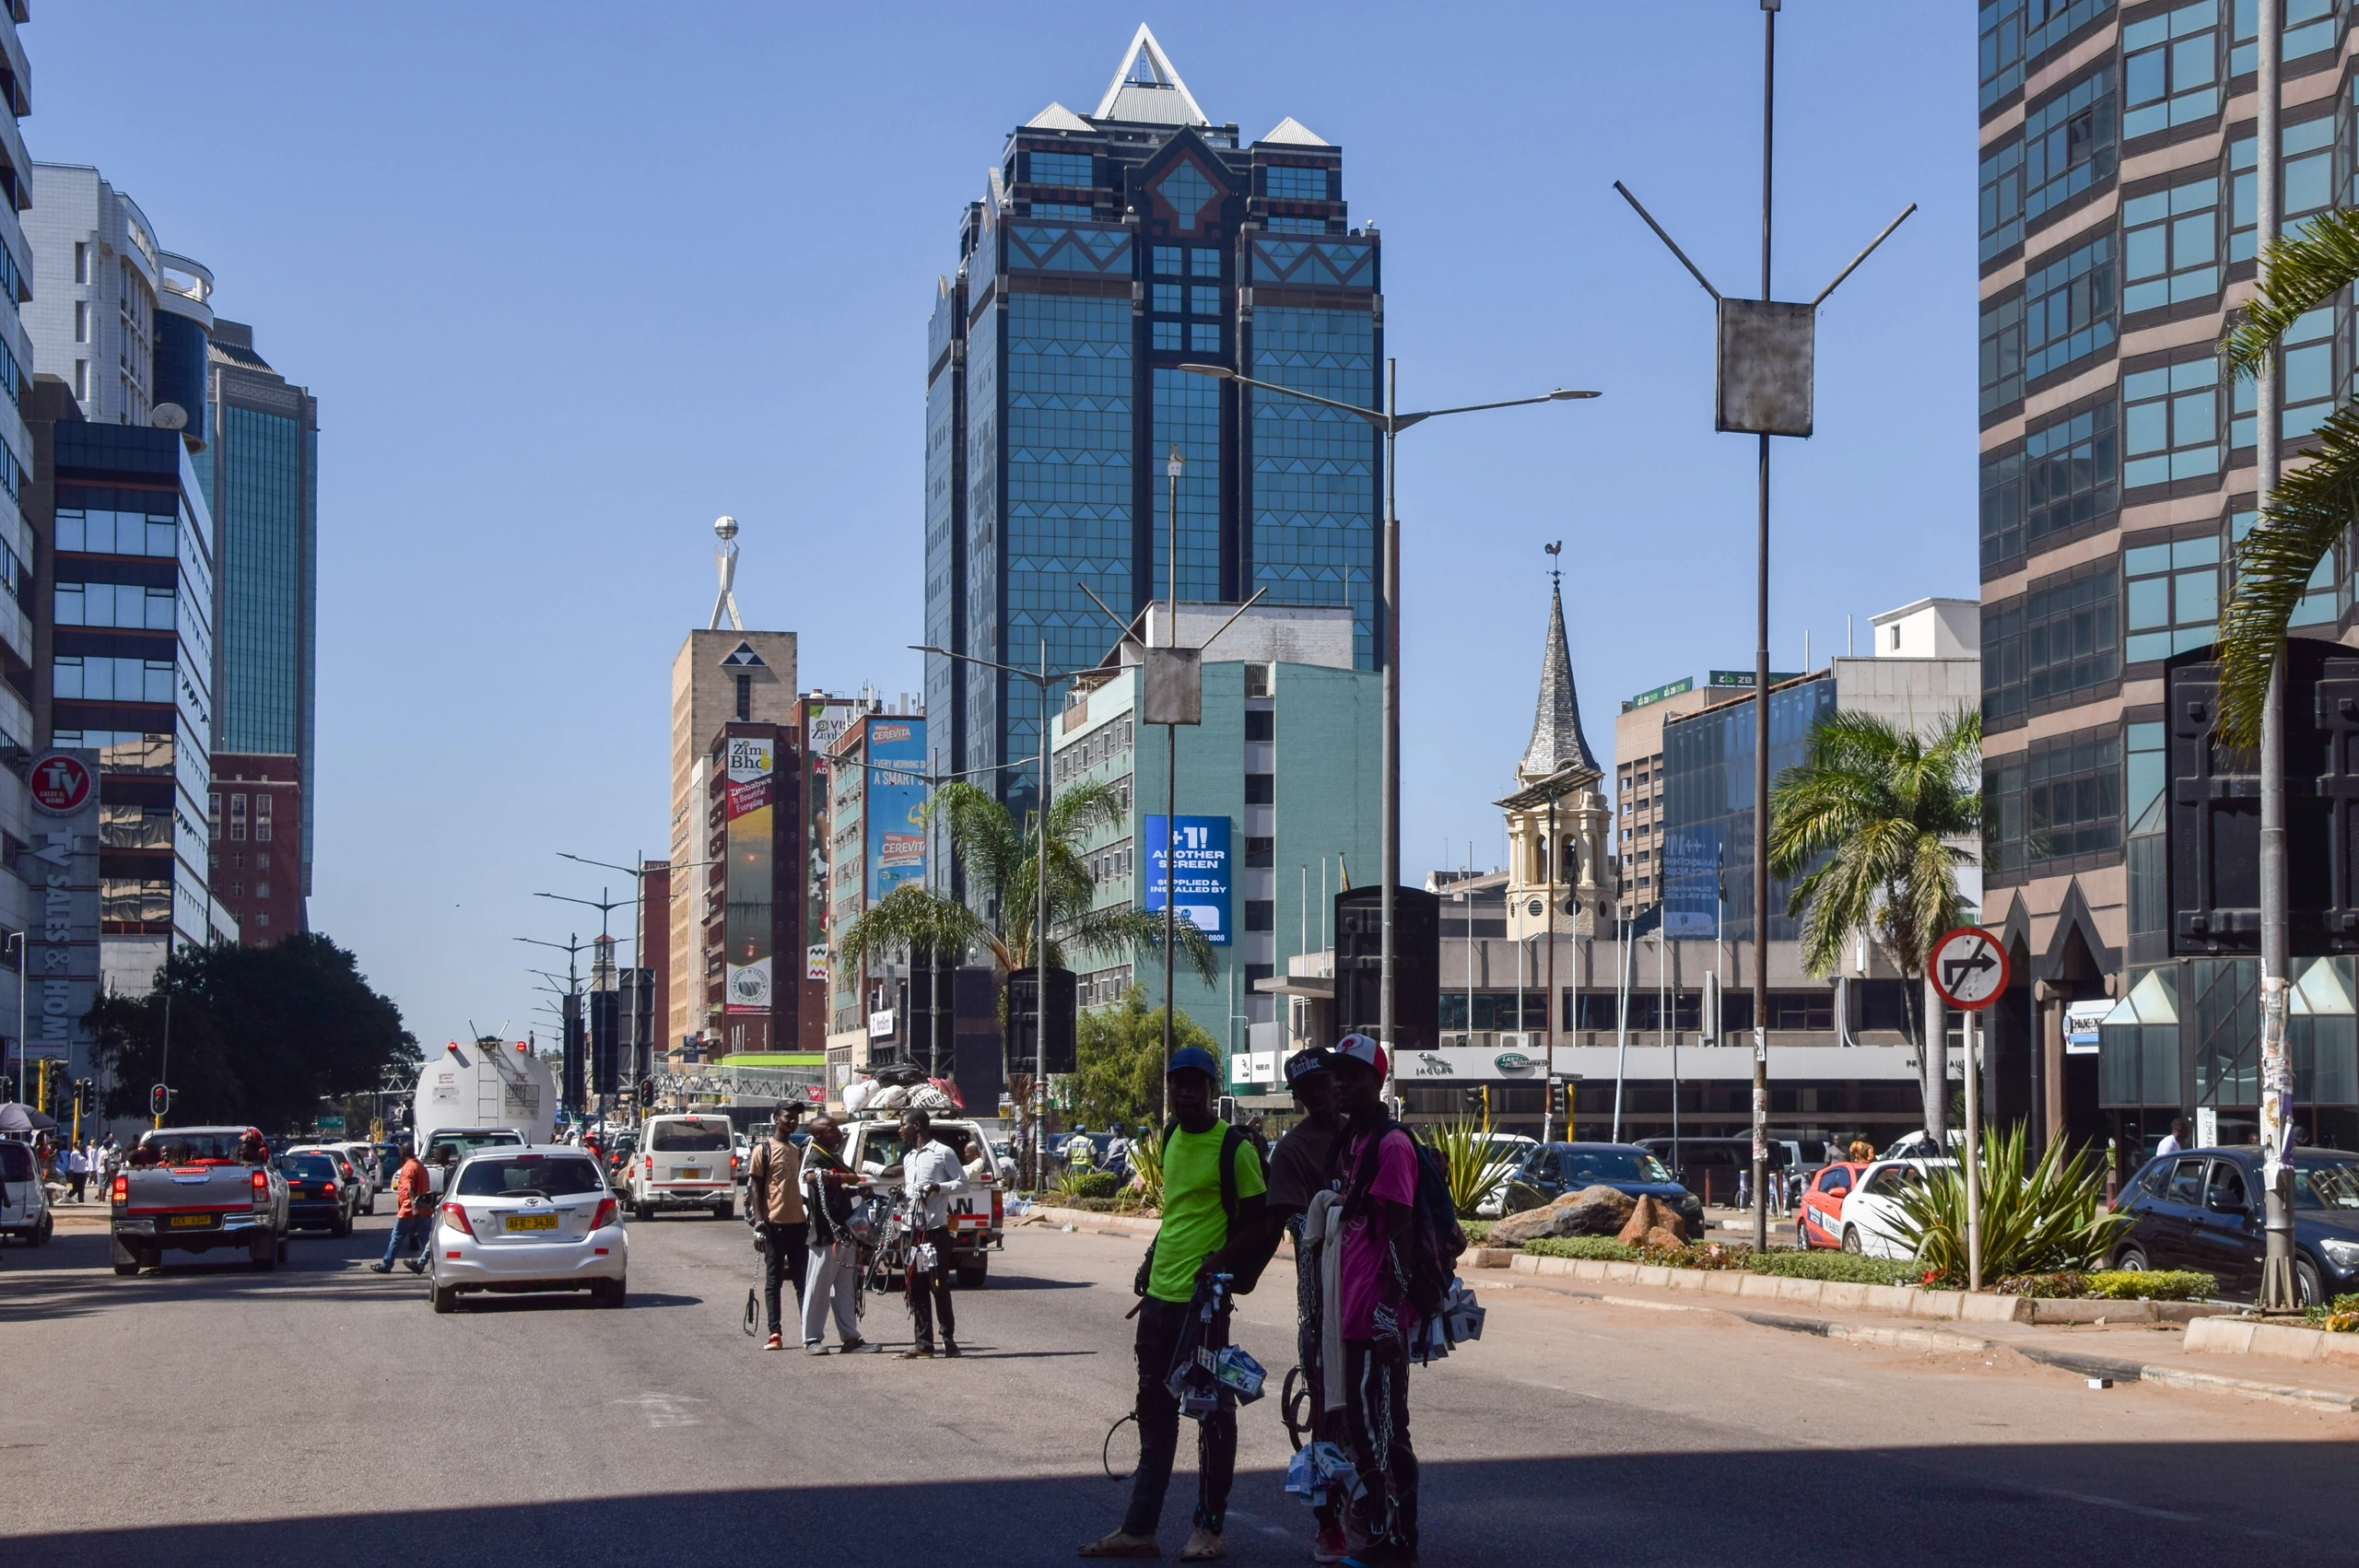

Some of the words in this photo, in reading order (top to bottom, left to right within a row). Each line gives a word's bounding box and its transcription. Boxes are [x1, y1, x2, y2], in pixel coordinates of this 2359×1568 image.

[872, 728, 910, 740] CEREVITA
[734, 742, 762, 755] Zim
[874, 759, 892, 768] EVERY
[893, 760, 919, 769] MORNING
[42, 762, 83, 800] TV
[874, 772, 880, 784] A
[883, 771, 914, 785] SMART
[730, 778, 772, 796] Zimbabwe
[739, 786, 766, 802] Beautiful
[737, 798, 763, 813] Everyday
[45, 874, 72, 943] SALES
[45, 949, 70, 968] &
[738, 991, 764, 1002] AUTHORITY
[42, 979, 69, 1040] HOM
[1416, 1067, 1454, 1076] JAGUAR
[509, 1219, 526, 1229] AFR
[534, 1217, 555, 1228] 3430
